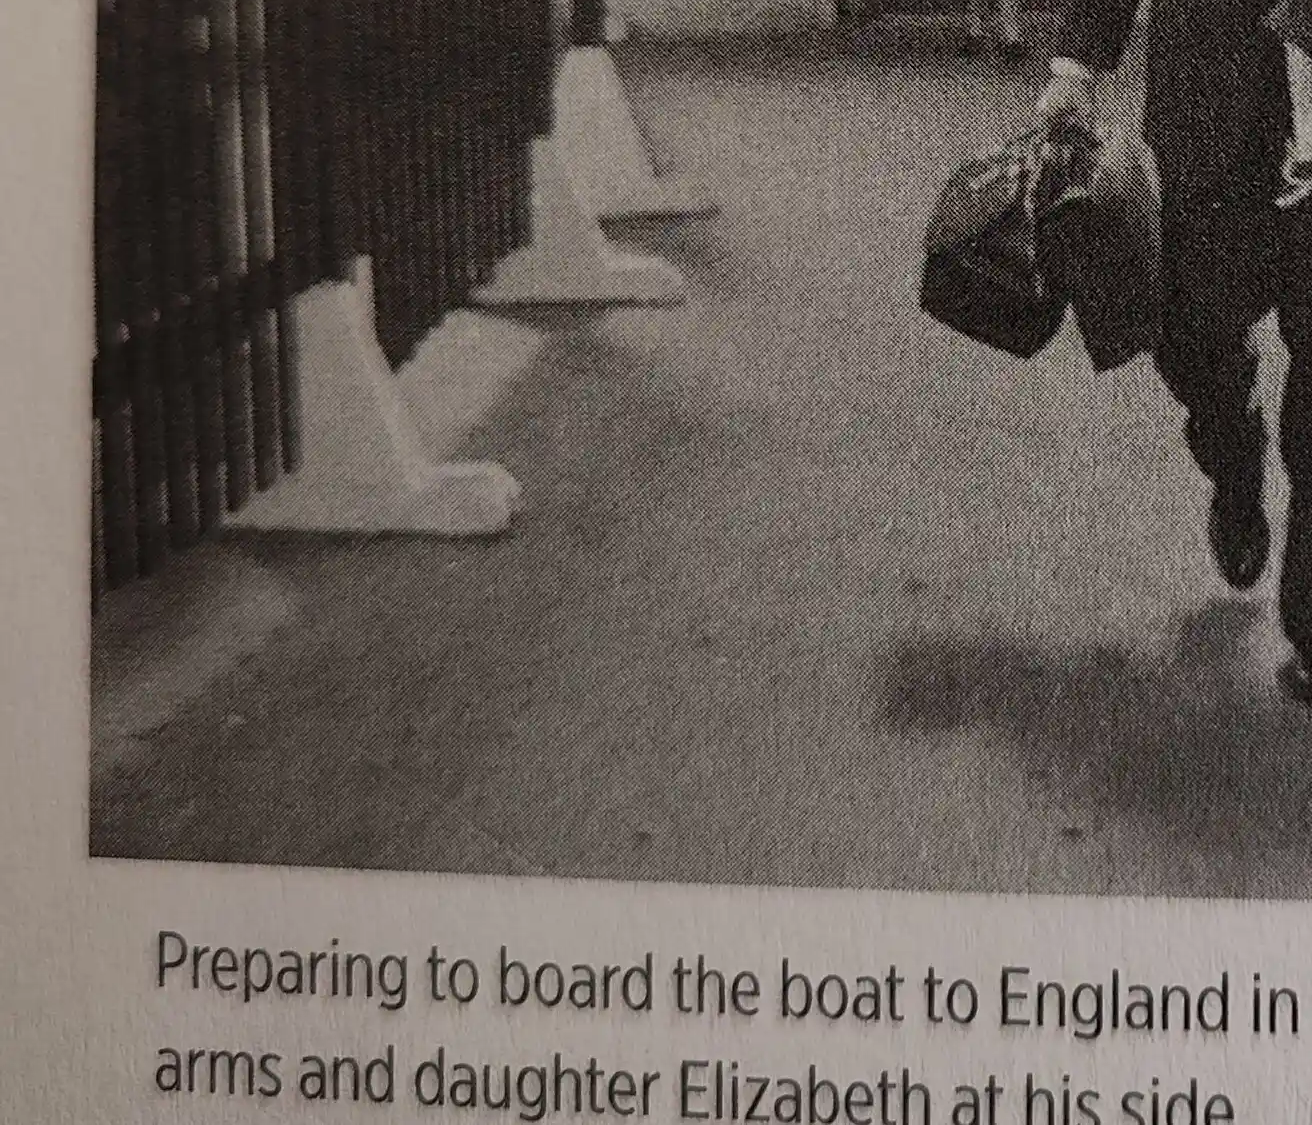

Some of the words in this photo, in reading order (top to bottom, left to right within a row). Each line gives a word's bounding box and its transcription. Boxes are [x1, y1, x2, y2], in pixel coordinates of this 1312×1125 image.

[156, 929, 409, 1012] Preparing
[425, 945, 481, 1010] to
[497, 945, 654, 1013] board
[672, 954, 761, 1018] the
[780, 957, 906, 1024] boat
[922, 966, 979, 1027] to
[998, 966, 1230, 1044] England
[1251, 971, 1300, 1036] in
[154, 1046, 284, 1101] arms
[297, 1044, 396, 1108] and
[412, 1046, 662, 1124] daughter
[678, 1059, 932, 1125] Elizabeth
[950, 1073, 1005, 1125] at
[1023, 1071, 1103, 1125] his
[1119, 1076, 1236, 1125] side
